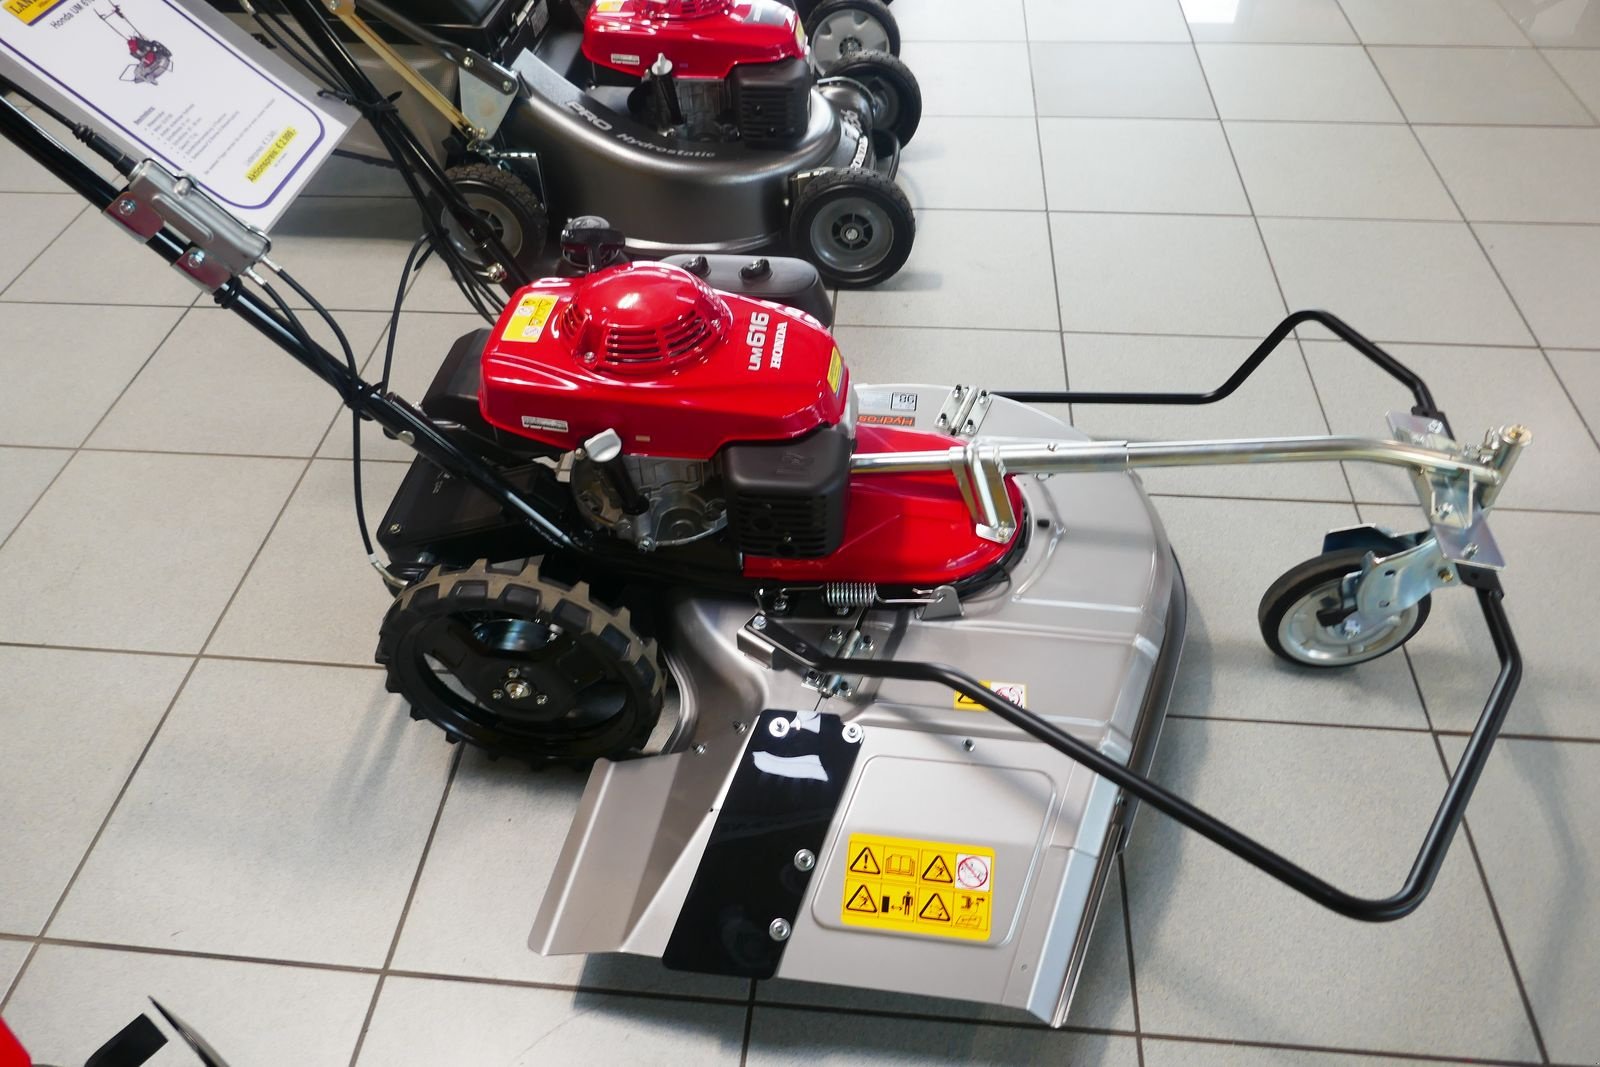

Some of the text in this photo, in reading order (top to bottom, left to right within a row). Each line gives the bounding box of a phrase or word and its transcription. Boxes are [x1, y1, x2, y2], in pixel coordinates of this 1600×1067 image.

[50, 12, 74, 29] Honda
[565, 101, 715, 158] PRO Hydrostatic
[769, 321, 788, 370] HONDA
